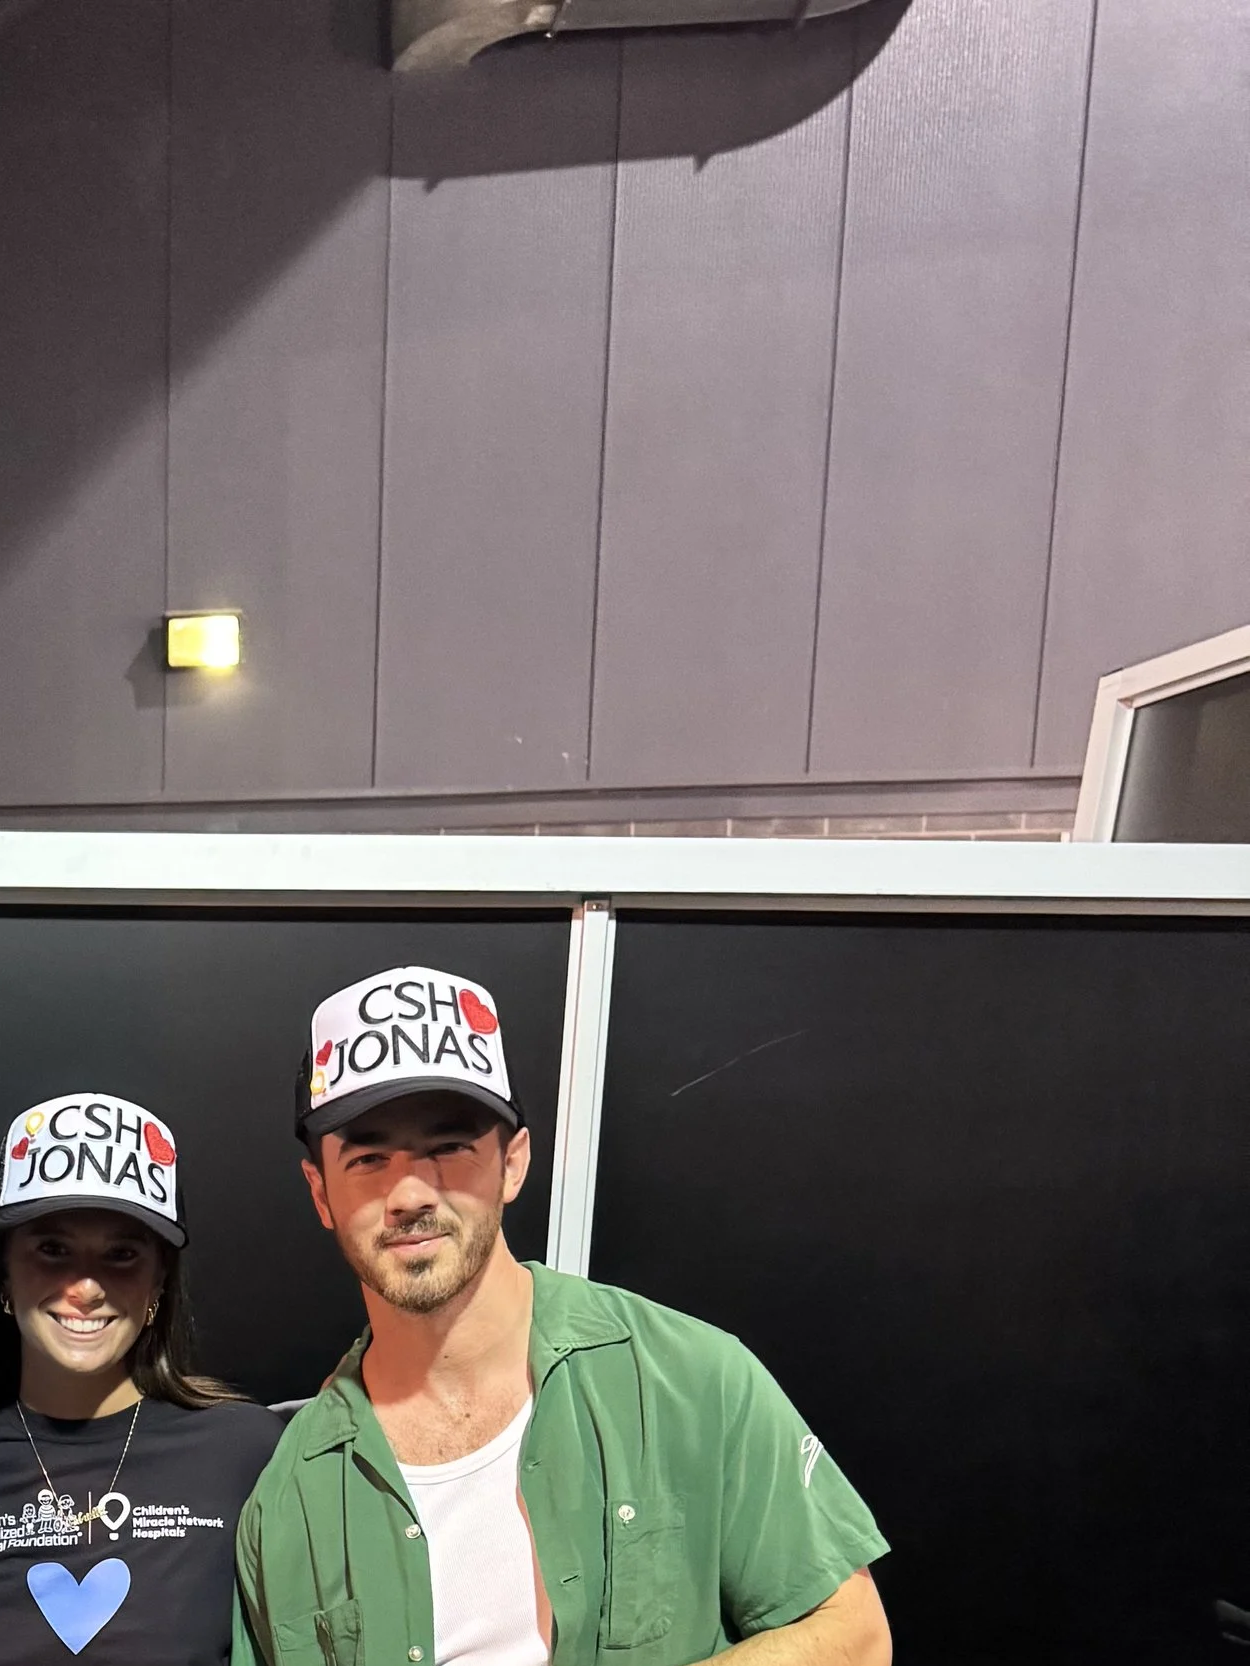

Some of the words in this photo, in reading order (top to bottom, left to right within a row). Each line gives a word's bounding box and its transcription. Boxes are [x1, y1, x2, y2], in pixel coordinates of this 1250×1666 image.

[358, 981, 462, 1026] CSH
[329, 1023, 493, 1087] JONAS
[49, 1103, 142, 1152] CSH
[19, 1142, 168, 1204] JONAS
[132, 1504, 190, 1517] Children's
[132, 1517, 175, 1529] Miracle
[177, 1515, 224, 1528] Network
[6, 1532, 79, 1549] Foundation
[132, 1527, 186, 1540] Hospitals
